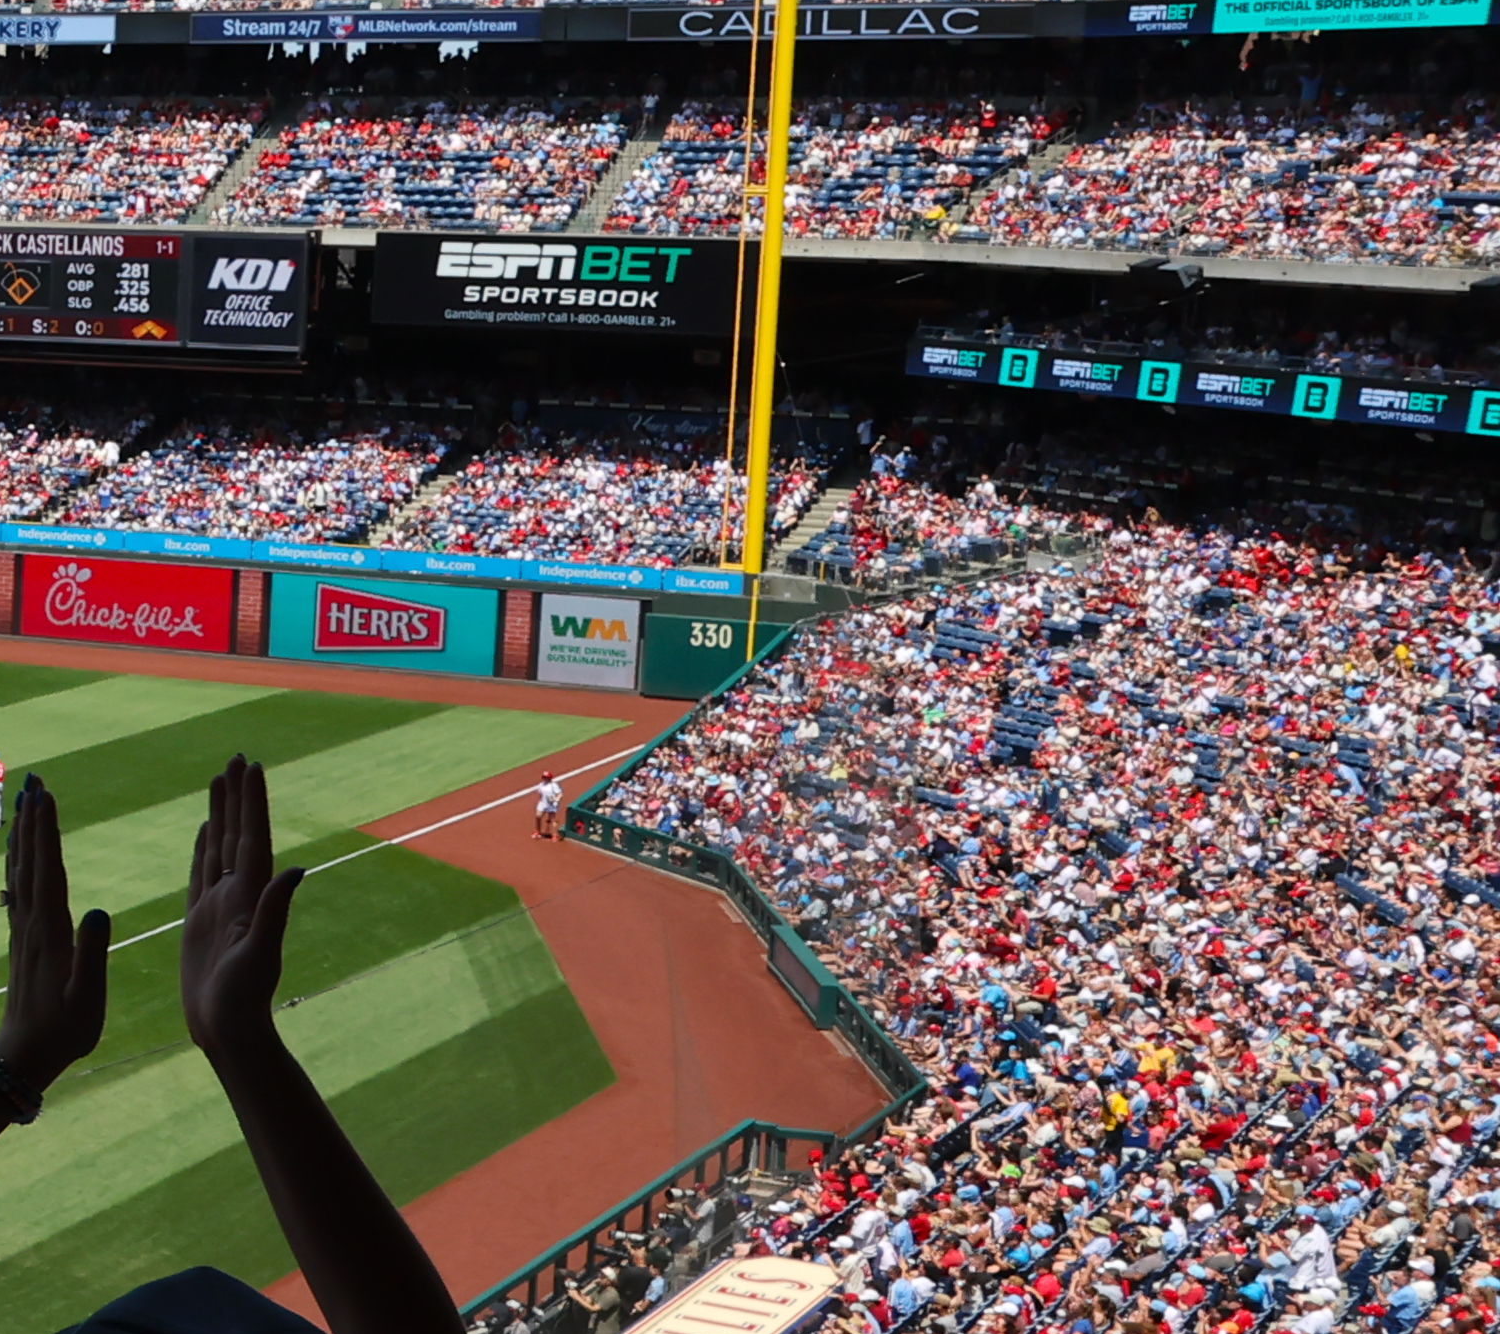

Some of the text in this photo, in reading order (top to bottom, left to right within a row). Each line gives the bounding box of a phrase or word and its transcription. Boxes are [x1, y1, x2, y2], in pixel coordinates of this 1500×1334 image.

[1224, 2, 1250, 14] THE
[223, 17, 518, 38] Stream 24/7 MLBNetwork.com/stream
[16, 234, 125, 257] CASTELLANOS
[436, 240, 693, 284] ESPN BET
[224, 293, 272, 311] OFFICE
[462, 284, 660, 309] SPORTSBOOK
[203, 308, 294, 330] TECHNOLOGY
[443, 307, 495, 325] Gambling
[496, 309, 547, 325] problem?
[548, 311, 568, 324] Call
[538, 564, 627, 583] Independence
[674, 574, 730, 590] ibx.com
[44, 573, 204, 639] Chick-fil-A
[327, 601, 430, 644] HERR'S
[689, 621, 733, 649] 330
